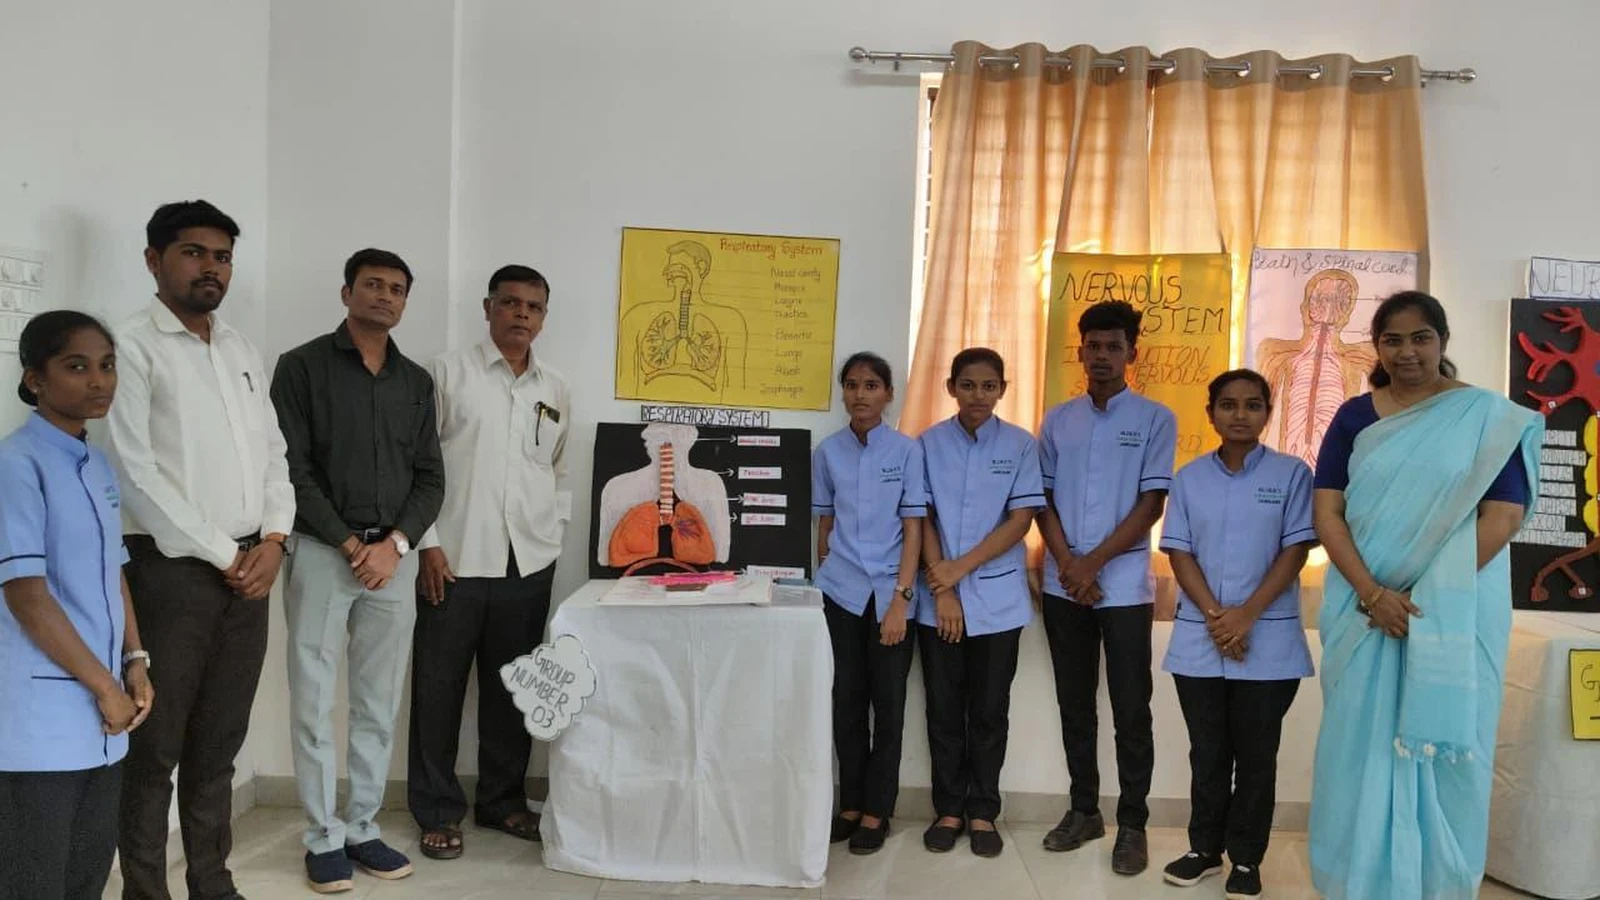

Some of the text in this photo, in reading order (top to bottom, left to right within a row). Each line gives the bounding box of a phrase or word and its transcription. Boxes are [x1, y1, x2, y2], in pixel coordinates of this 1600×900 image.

[1059, 269, 1182, 305] NERVOUS
[1141, 305, 1223, 337] STEM
[643, 405, 765, 428] RESPIRATORY SYSTEM
[535, 648, 576, 689] GROUP
[510, 666, 570, 717] NUMBER
[531, 705, 556, 728] 03
